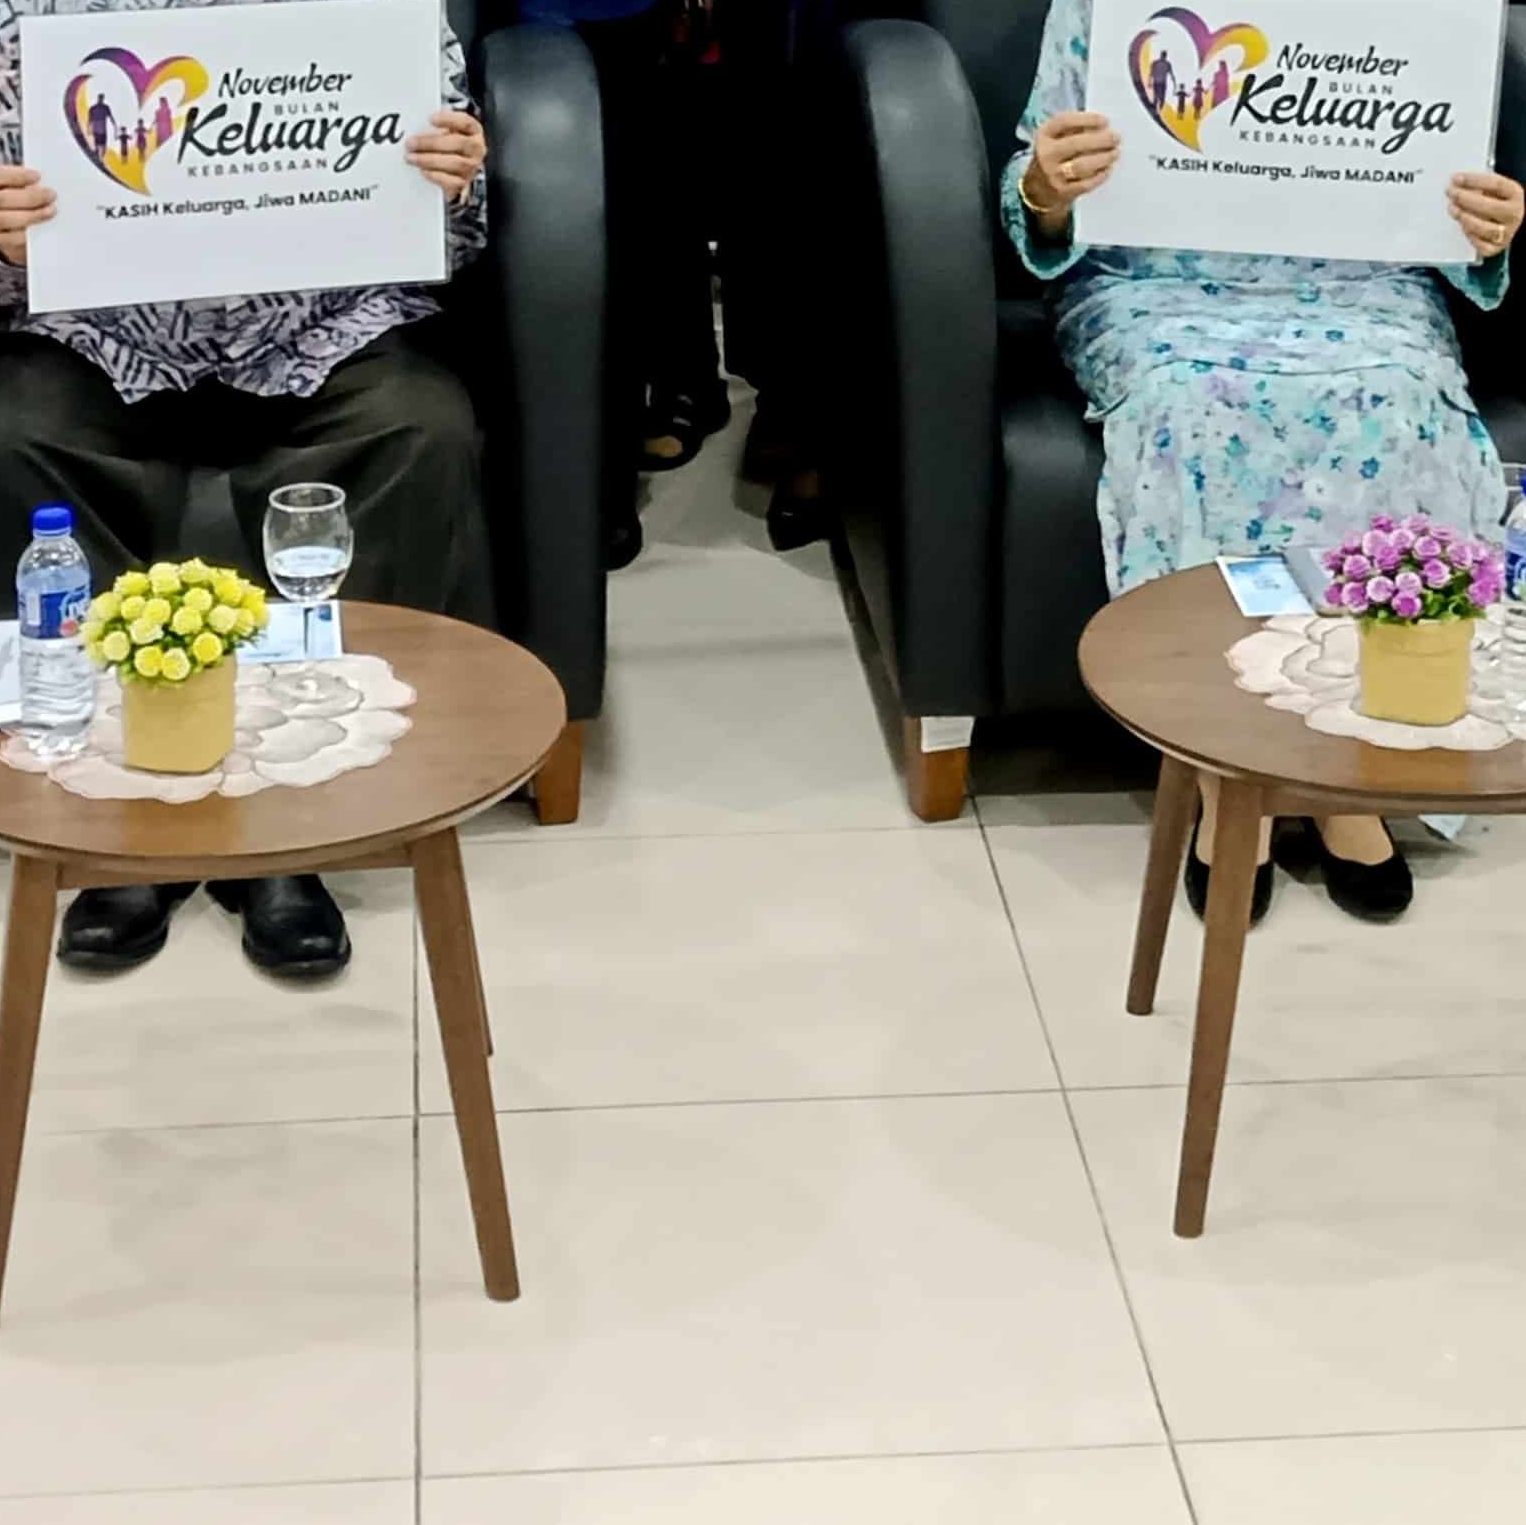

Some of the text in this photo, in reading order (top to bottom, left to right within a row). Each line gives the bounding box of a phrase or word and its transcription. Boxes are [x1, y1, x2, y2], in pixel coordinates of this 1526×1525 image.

[1277, 43, 1409, 76] November
[218, 62, 353, 98] November
[1329, 82, 1393, 95] BULAN
[274, 101, 340, 115] BULAN
[1230, 73, 1454, 155] Keluarga
[177, 102, 404, 173] Keluarga
[1239, 130, 1375, 148] KEBANGSAAN
[188, 159, 327, 178] KEBANGSAAN
[1212, 159, 1296, 181] Keluarga,
[1300, 164, 1340, 181] Jiwa
[163, 198, 248, 217] Keluarga,
[254, 193, 294, 209] Jiwa
